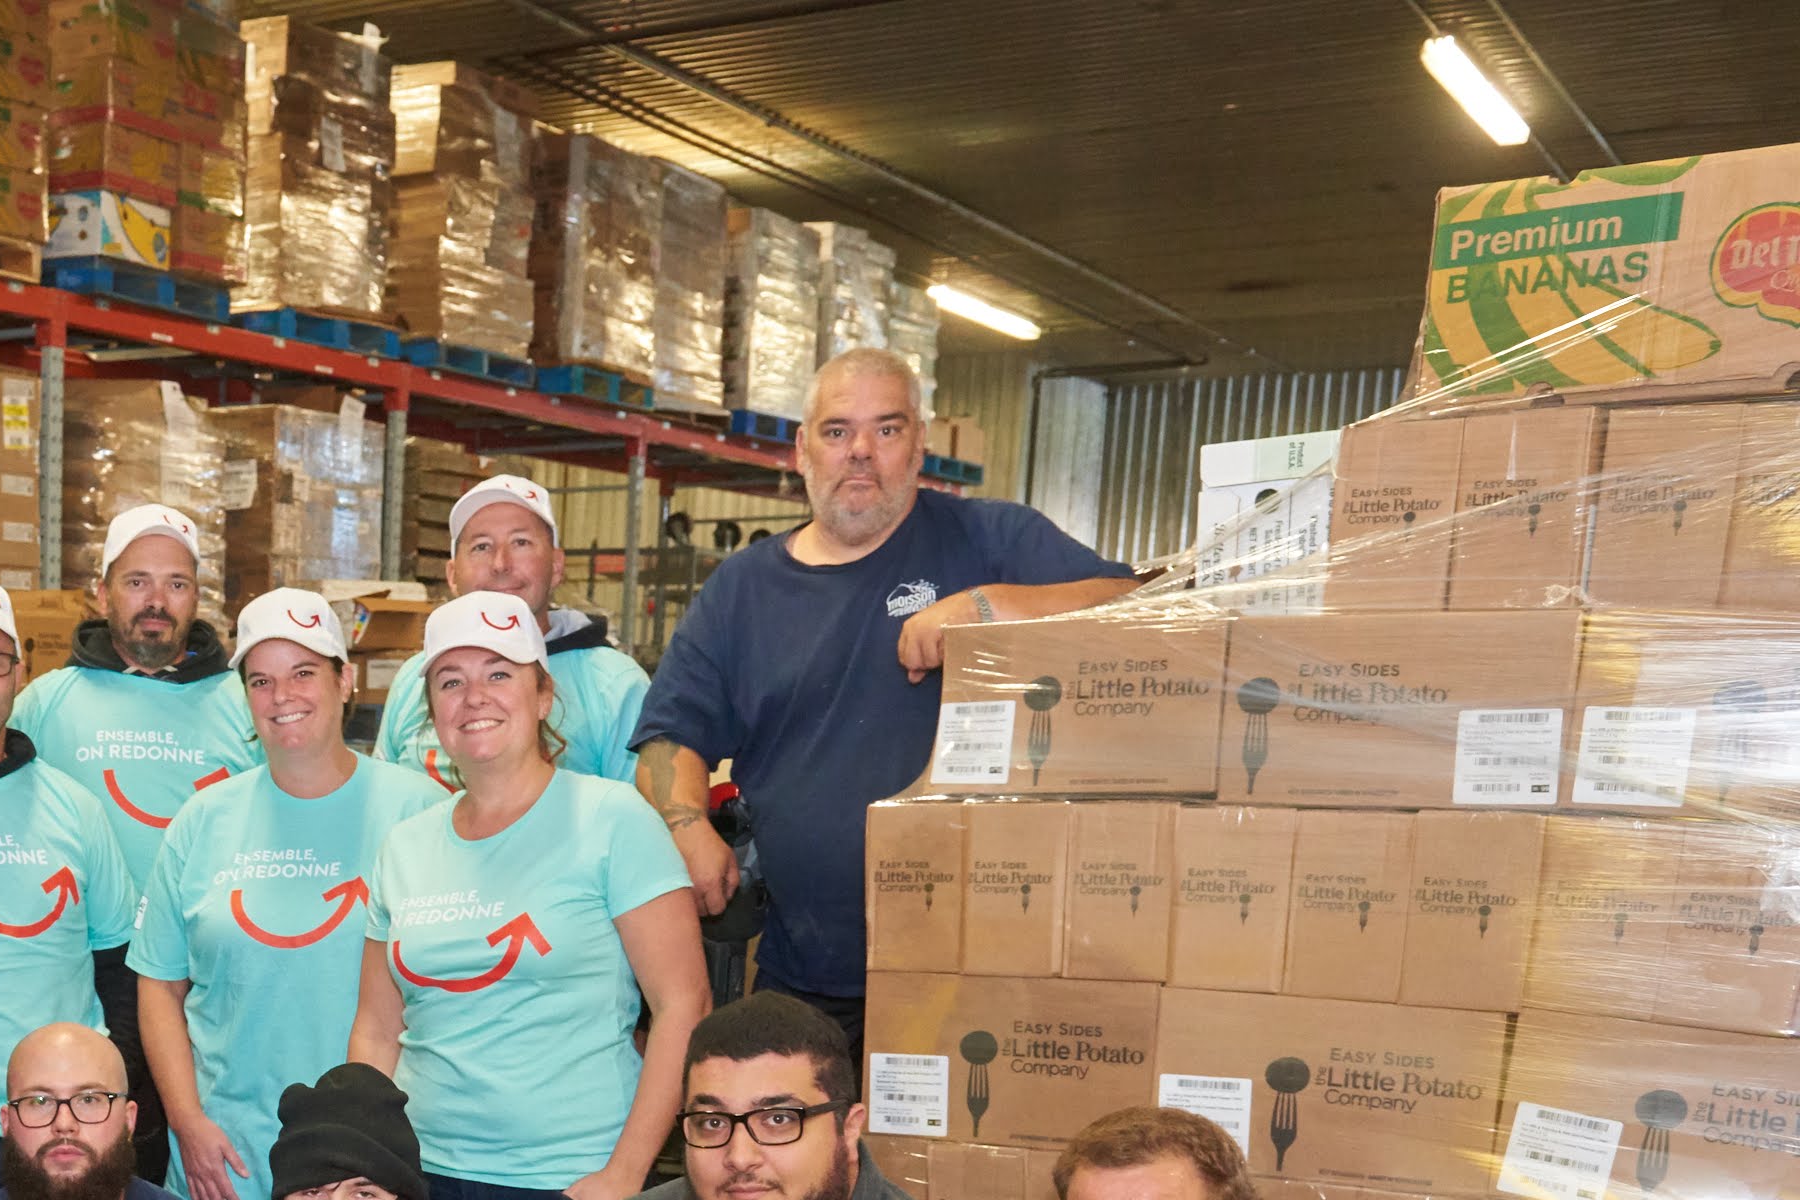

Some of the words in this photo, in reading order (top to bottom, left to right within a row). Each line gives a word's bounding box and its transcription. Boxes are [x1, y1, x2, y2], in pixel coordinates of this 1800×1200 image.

[1450, 216, 1623, 261] Premium
[1729, 235, 1780, 269] Del
[1447, 252, 1649, 304] BANANAS
[1078, 661, 1119, 675] EASY
[1124, 659, 1168, 673] SIDES
[1077, 677, 1135, 700] Little
[1141, 677, 1209, 698] Potato
[1074, 701, 1154, 717] Company
[76, 746, 104, 763] ON
[108, 744, 205, 765] REDONNE
[243, 860, 342, 880] REDONNE
[1013, 1021, 1052, 1035] EASY
[1059, 1022, 1103, 1037] SIDES
[1012, 1040, 1070, 1061] Little
[1075, 1041, 1144, 1065] Potato
[1329, 1047, 1377, 1065] EASY
[1383, 1050, 1435, 1069] SIDES
[1011, 1059, 1090, 1080] Company
[1327, 1066, 1395, 1092] Little
[1401, 1071, 1482, 1101] Potato
[1324, 1088, 1417, 1114] Company
